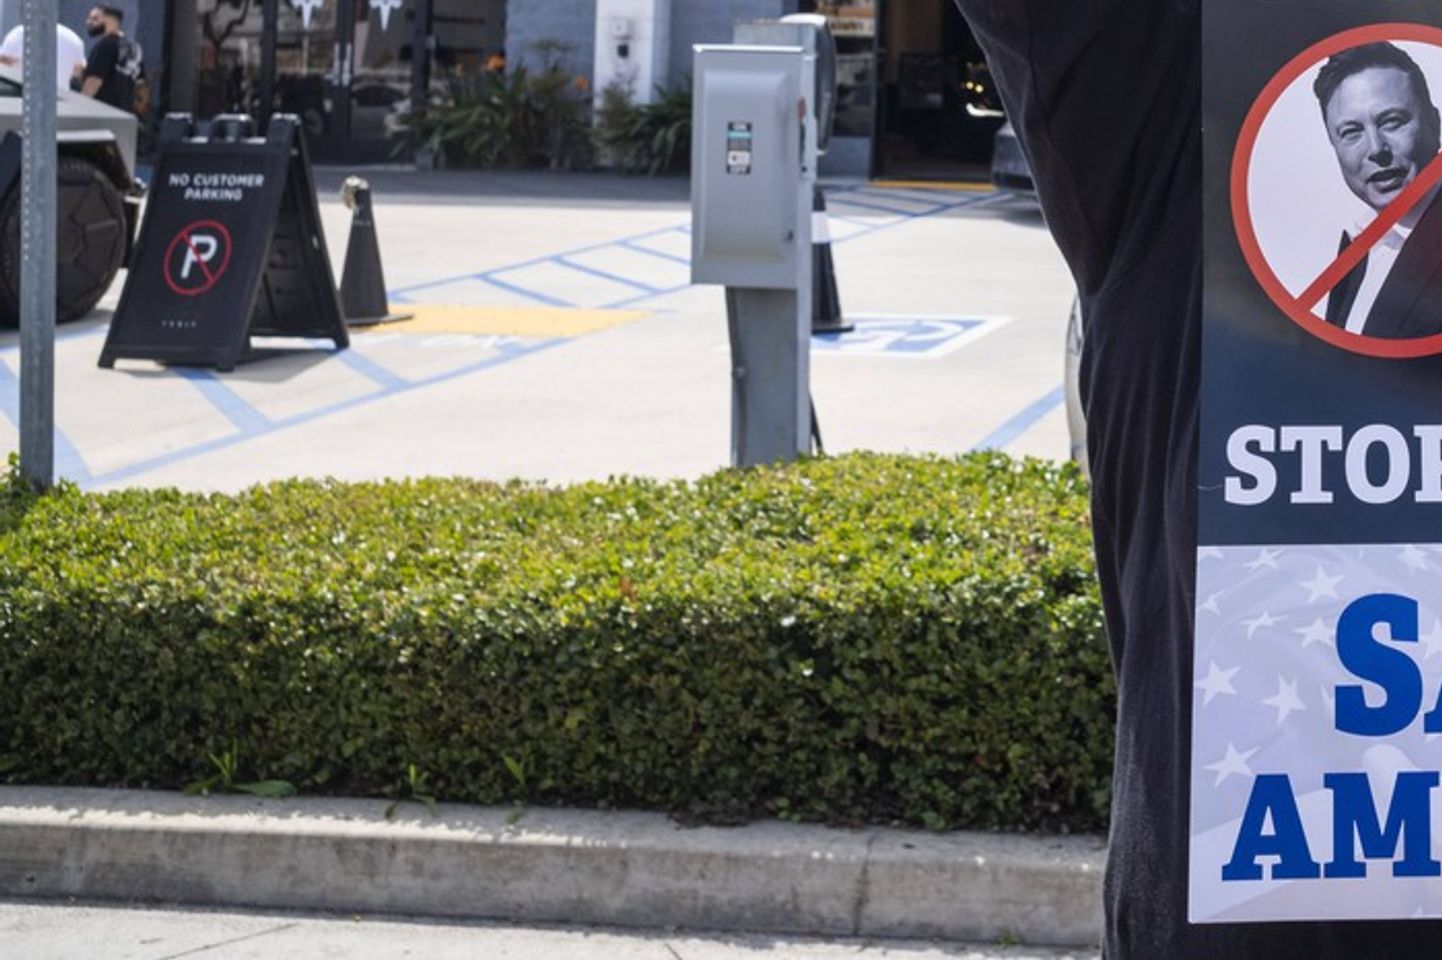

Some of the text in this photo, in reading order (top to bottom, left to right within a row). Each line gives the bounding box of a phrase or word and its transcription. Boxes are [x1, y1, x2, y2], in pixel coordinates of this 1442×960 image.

[169, 173, 265, 187] NO CUSTOMER
[184, 188, 243, 201] PARKING
